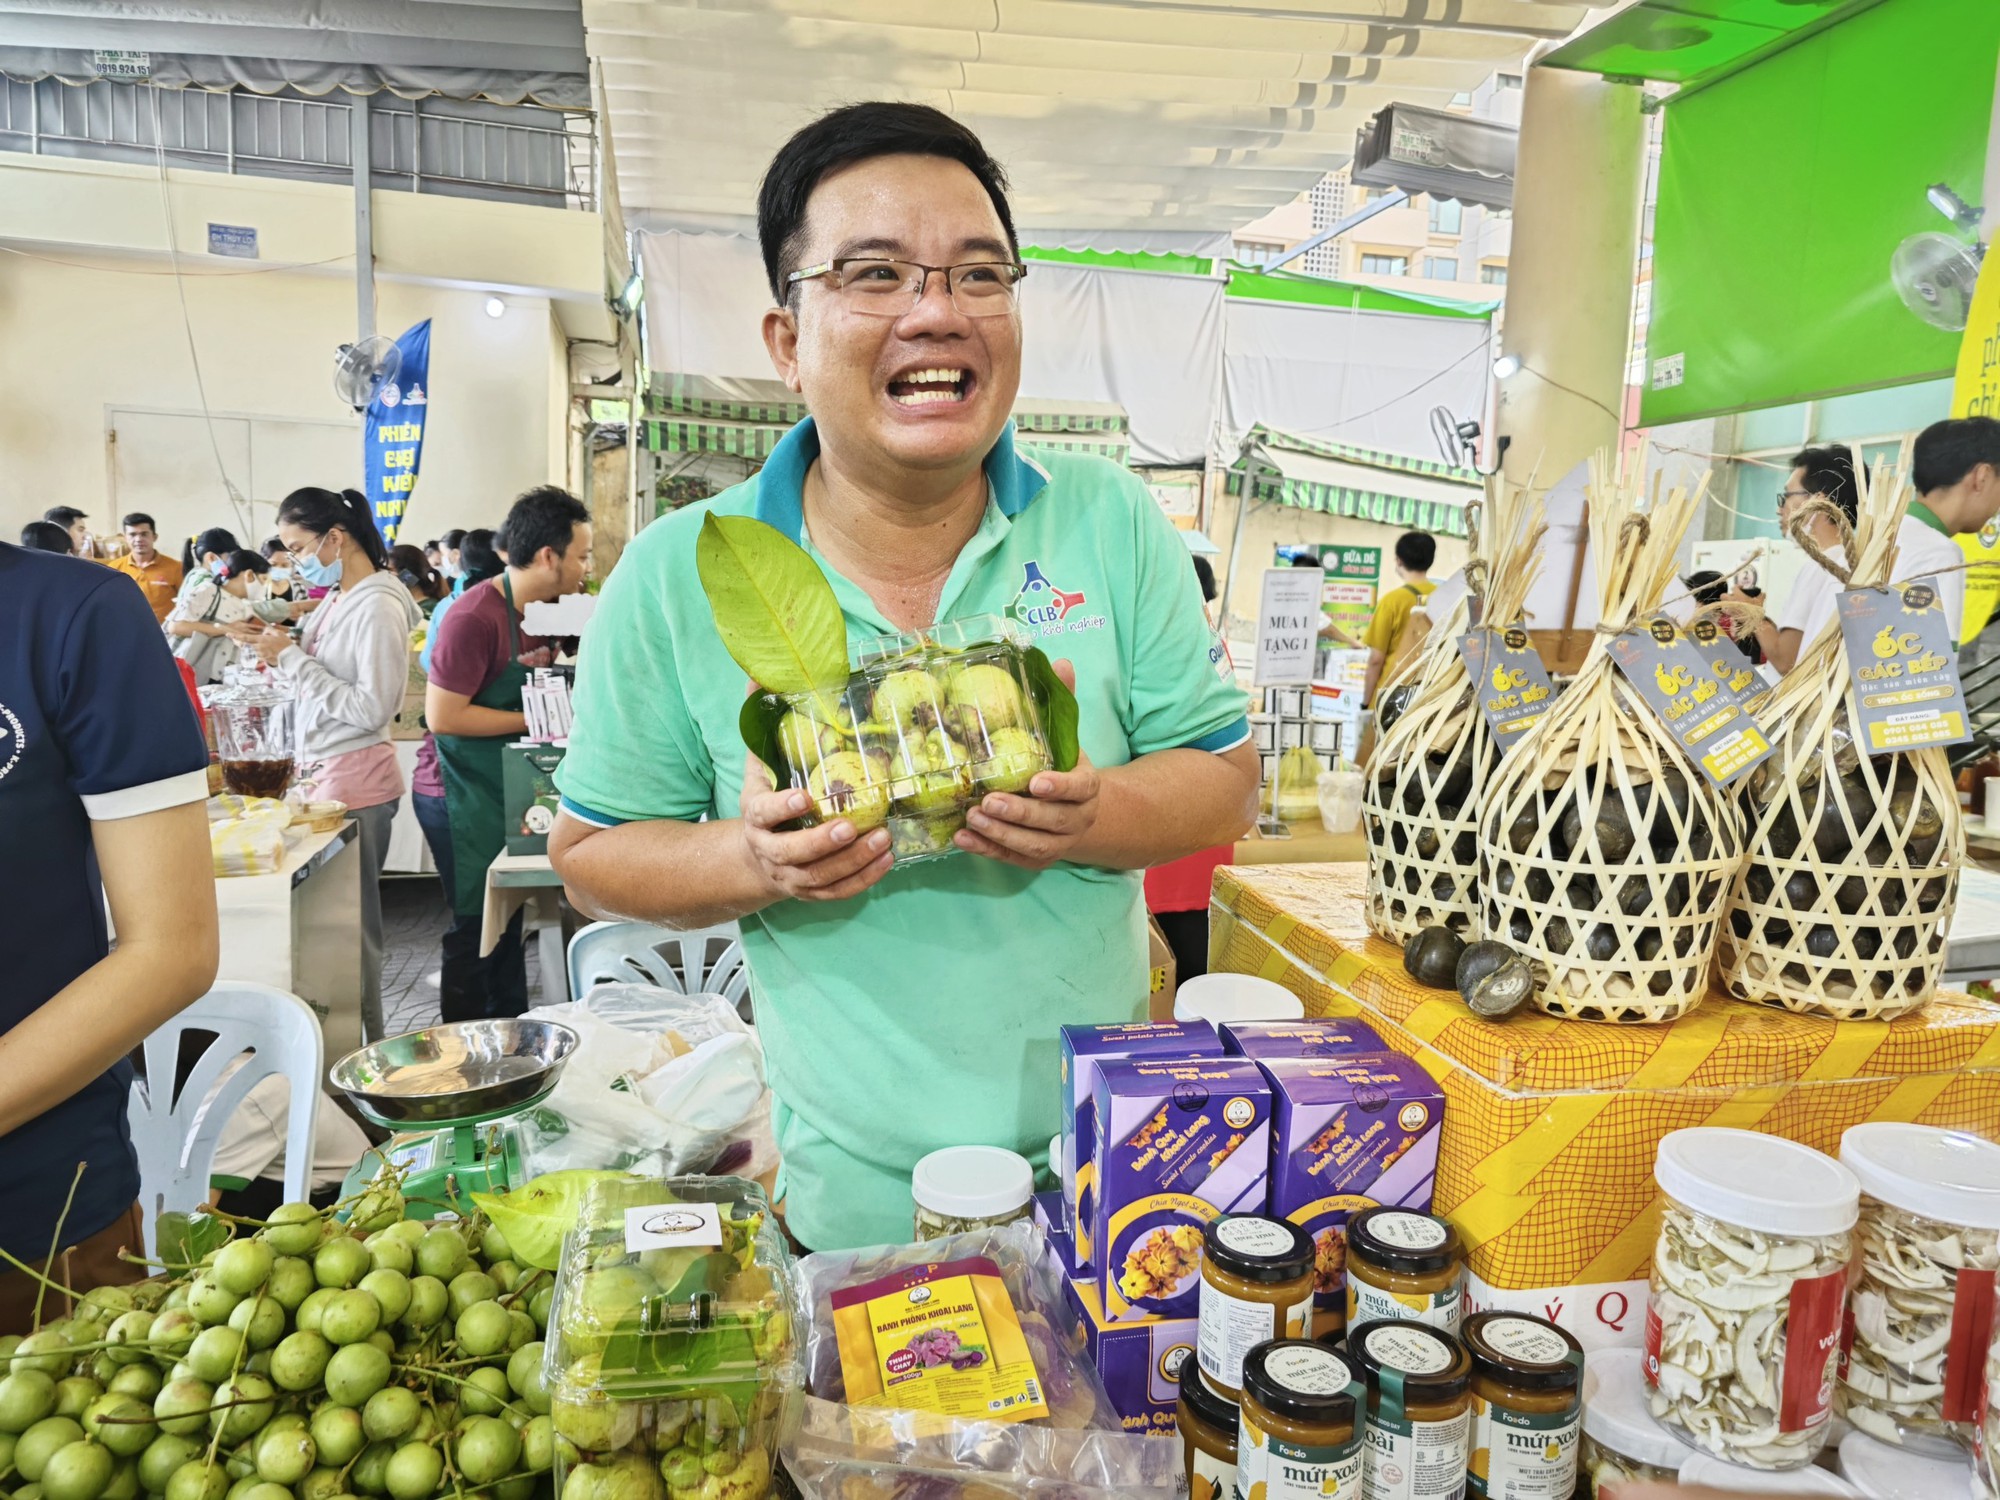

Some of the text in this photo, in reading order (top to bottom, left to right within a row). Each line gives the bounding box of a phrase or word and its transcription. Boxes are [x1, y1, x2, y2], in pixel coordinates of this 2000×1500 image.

[96, 64, 151, 75] 0919.924.151
[1027, 606, 1058, 625] CLB
[1269, 616, 1308, 629] MUA 1
[1303, 638, 1308, 650] 1
[1872, 625, 1924, 659] ỐC
[1857, 650, 1948, 681] GÁC BẾP
[1491, 663, 1530, 693] ỐC
[1655, 663, 1694, 696] ỐC
[1487, 683, 1550, 713] GÁC BẾP
[1663, 696, 1695, 721] GÁC
[1160, 1114, 1211, 1162] Khoai Lang
[1335, 1119, 1386, 1167] Khoai Lang
[1130, 1129, 1178, 1172] Bánh Quy
[1161, 1132, 1218, 1190] Sweet potato cookies
[1307, 1134, 1354, 1176] Bánh Quy
[928, 1306, 952, 1319] KHOAI
[953, 1302, 974, 1313] LANG
[1364, 1292, 1389, 1308] mứt
[893, 1361, 911, 1371] CHAY
[1121, 1412, 1150, 1429] ánh
[1502, 1412, 1531, 1426] Foodo
[1365, 1430, 1394, 1453] oài
[1506, 1432, 1553, 1449] mứt
[1279, 1444, 1307, 1459] Foodo
[1283, 1464, 1328, 1484] mứt
